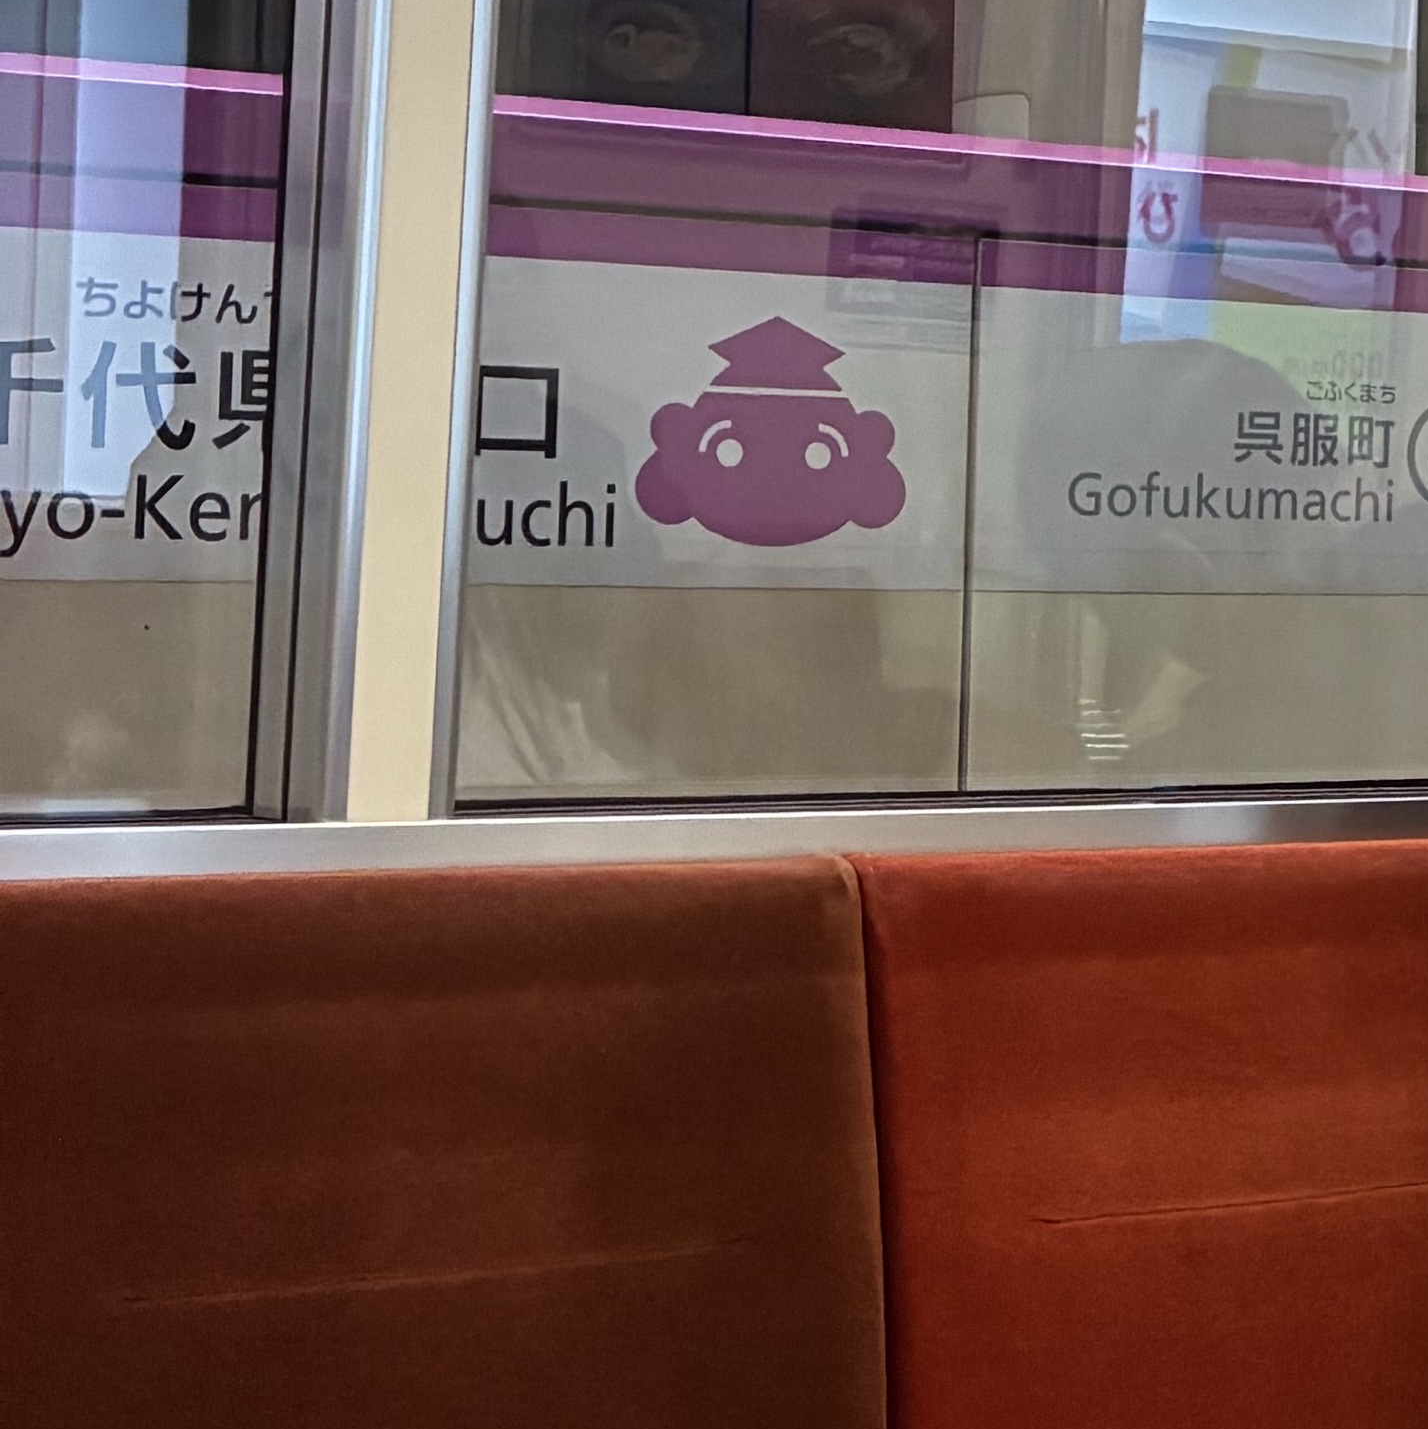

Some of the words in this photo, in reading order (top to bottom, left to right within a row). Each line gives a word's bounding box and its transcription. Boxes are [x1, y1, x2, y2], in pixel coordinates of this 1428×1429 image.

[74, 276, 276, 325] ちよけん
[1305, 378, 1397, 405] ごふくまち
[1233, 410, 1396, 469] 呉服町
[1067, 472, 1395, 523] Gofukumachi
